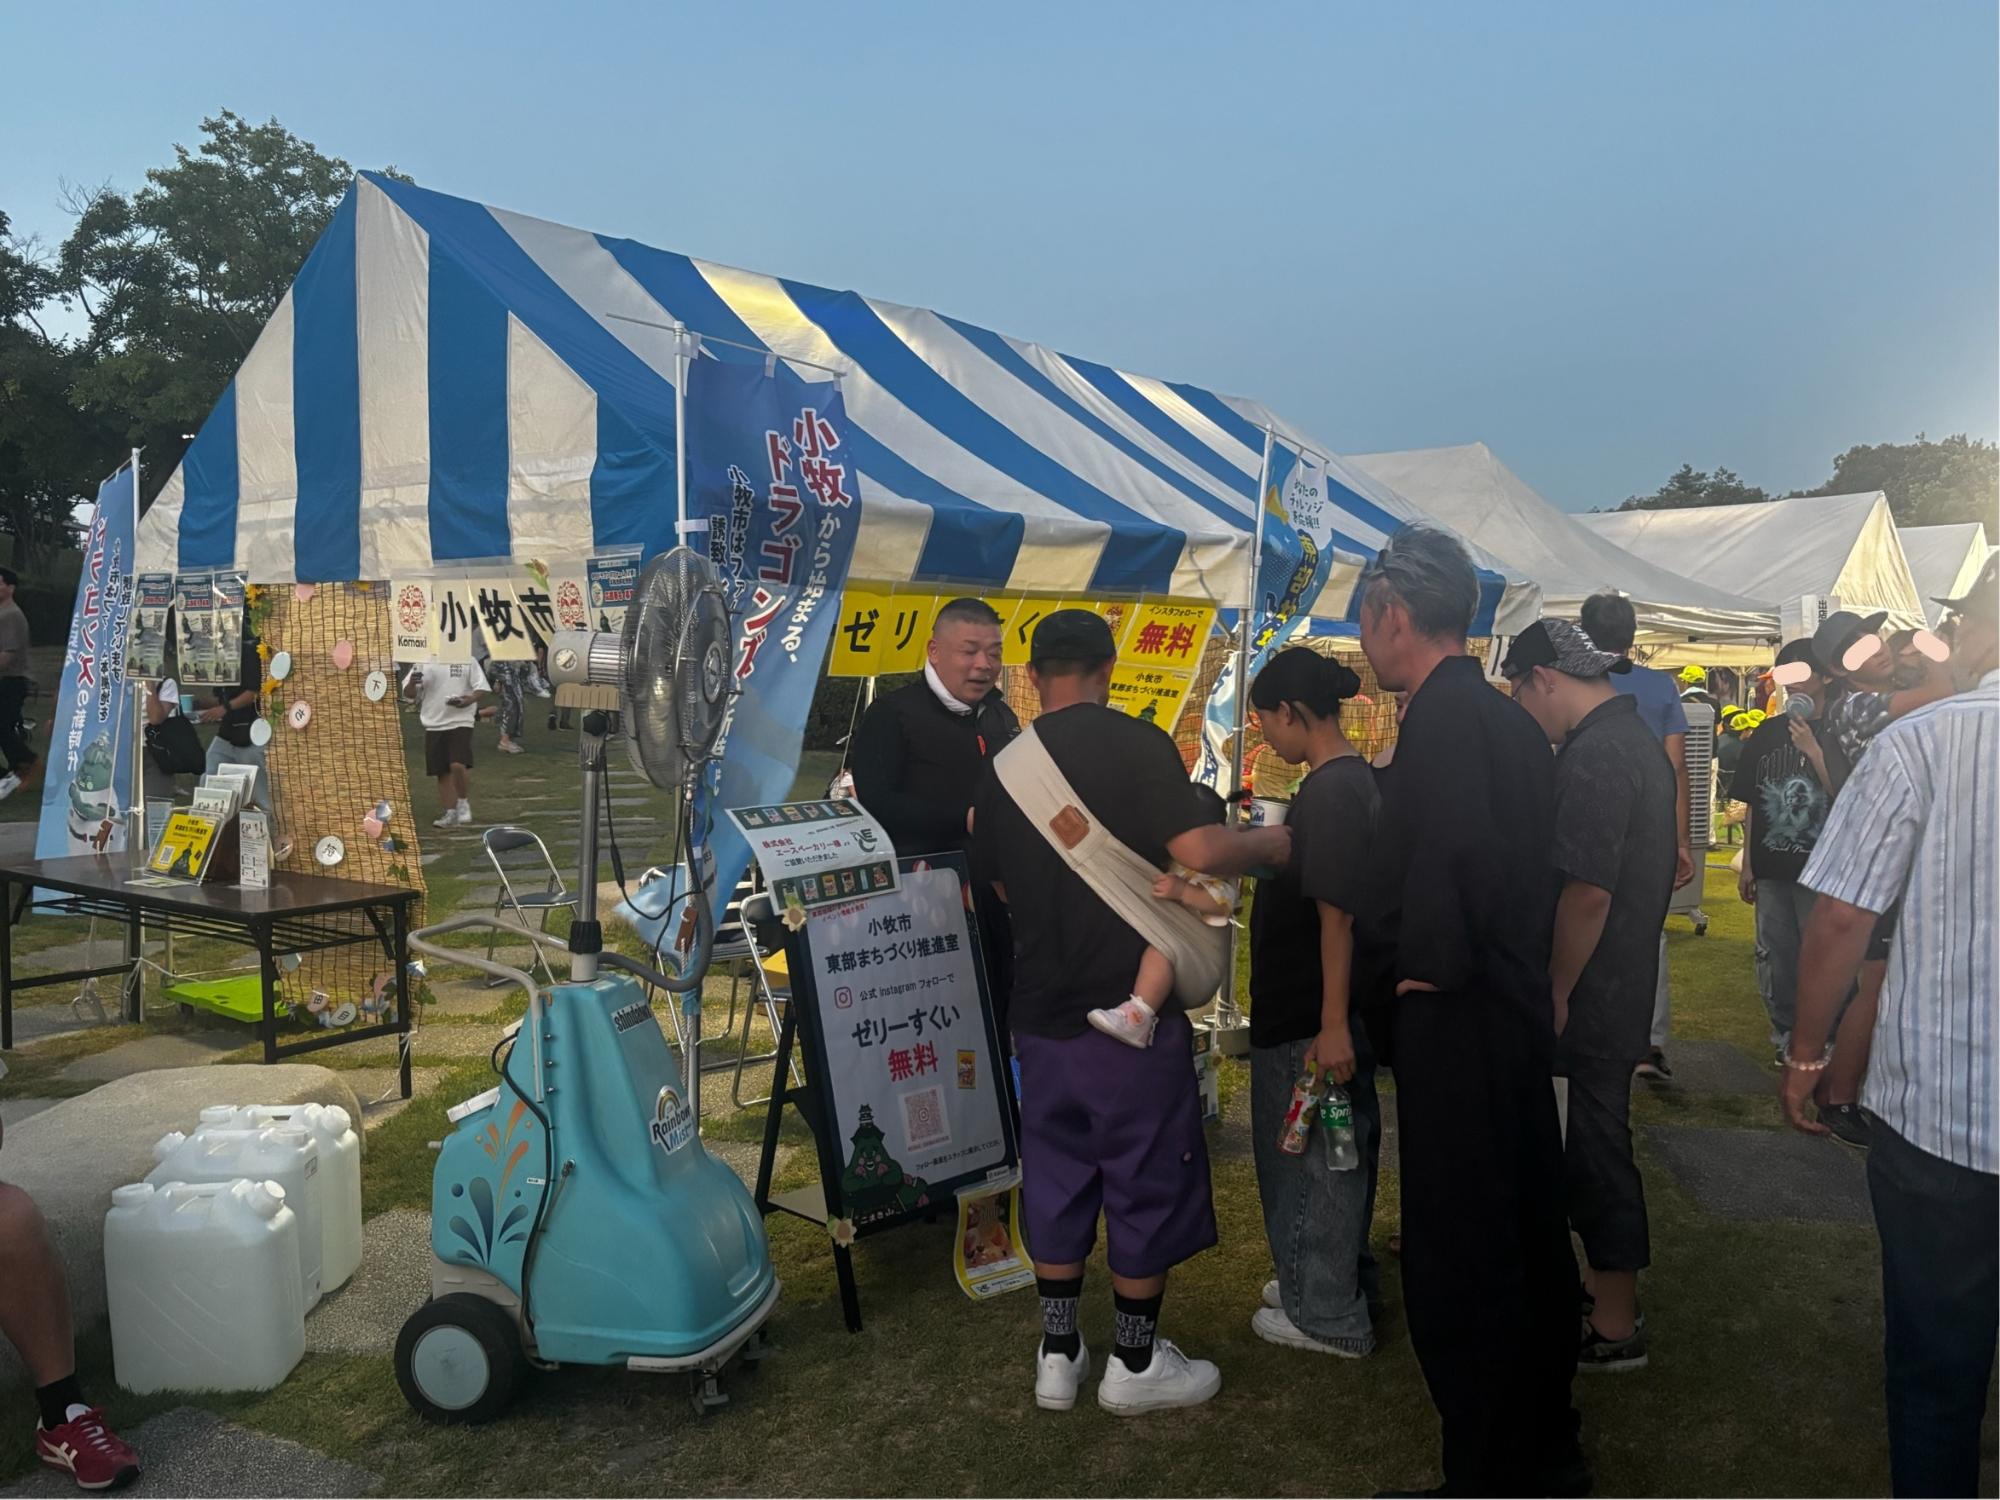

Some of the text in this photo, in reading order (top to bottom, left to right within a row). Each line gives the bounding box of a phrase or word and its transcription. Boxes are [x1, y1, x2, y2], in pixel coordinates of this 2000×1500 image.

[439, 586, 556, 643] 小牧市
[1818, 599, 1828, 623] 出店
[397, 634, 427, 649] Komaki
[1133, 619, 1198, 659] 無料
[868, 913, 912, 937] 小牧市
[825, 933, 961, 975] 東部まちづくり推進室
[860, 988, 878, 1002] 公式
[918, 973, 956, 991] フォローで
[851, 1004, 961, 1048] ゼリーすくい
[887, 1039, 939, 1083] 無料
[651, 1103, 691, 1146] Rainbow
[669, 1128, 689, 1151] Mist
